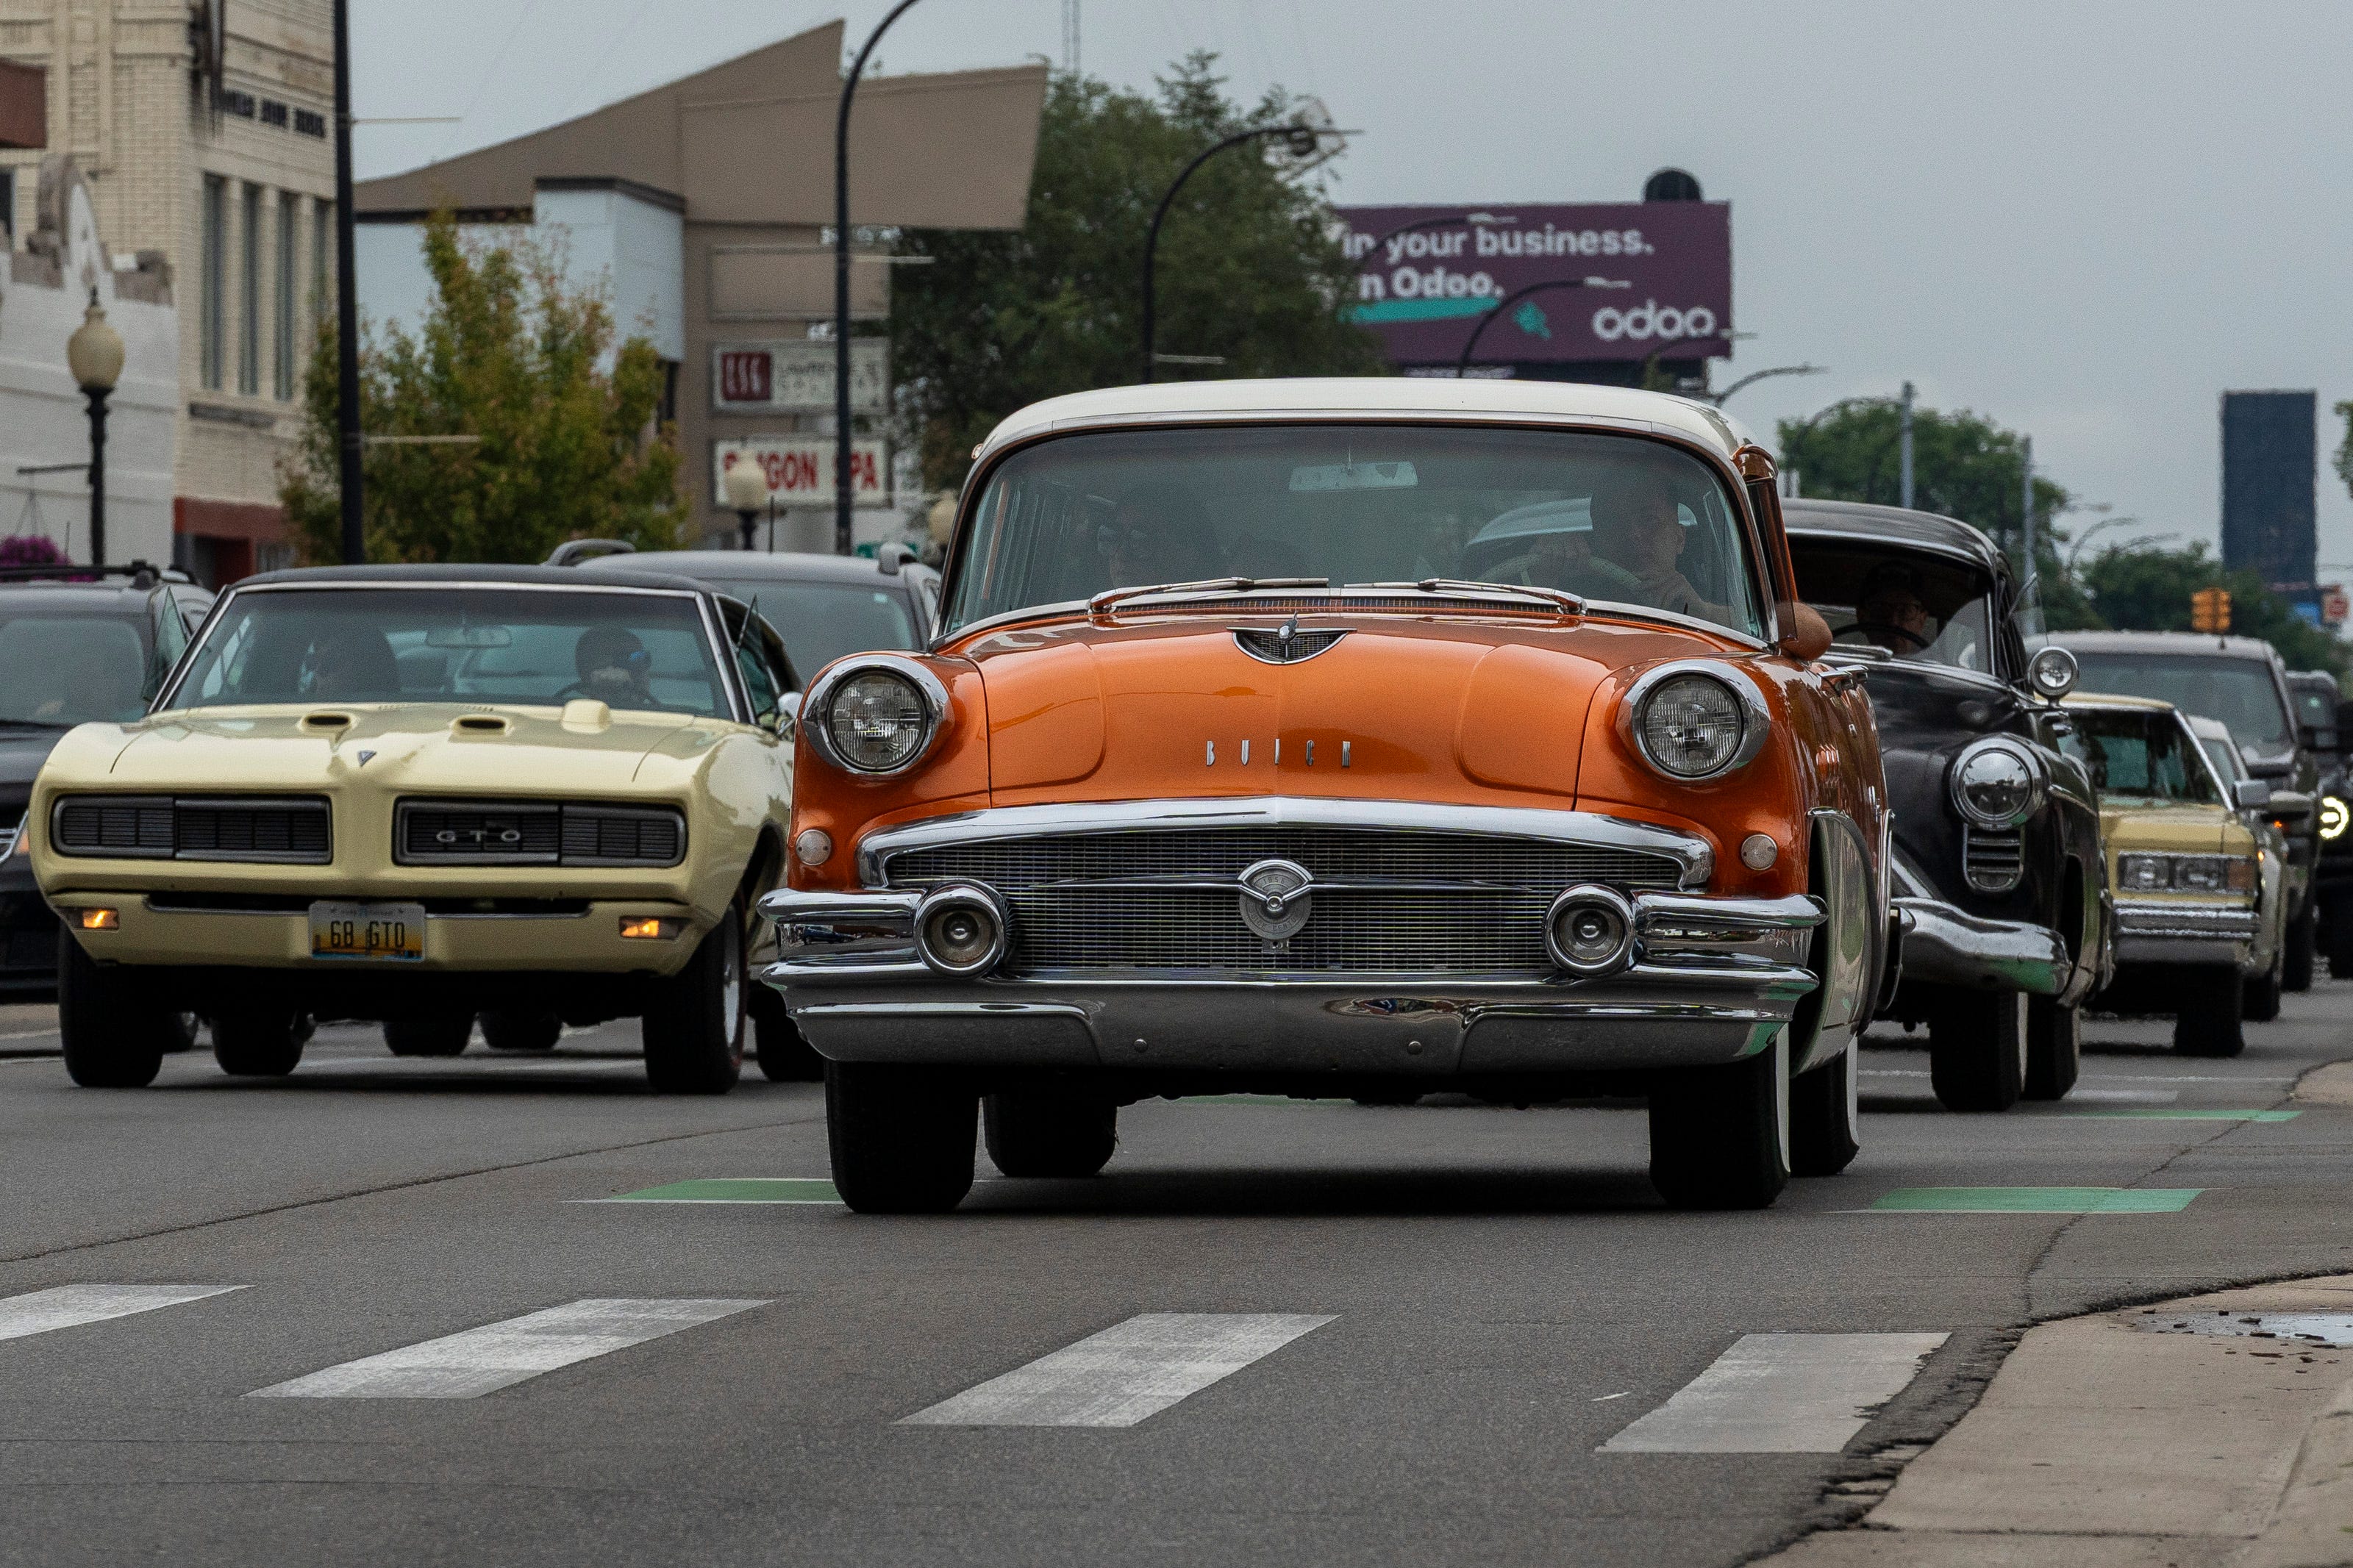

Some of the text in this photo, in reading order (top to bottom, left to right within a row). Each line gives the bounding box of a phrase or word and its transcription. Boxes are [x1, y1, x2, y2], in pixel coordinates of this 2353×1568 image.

[1385, 232, 1468, 265] your
[1477, 223, 1654, 256] business.
[1392, 266, 1505, 298] Odoo.
[1592, 299, 1717, 341] odoo
[1205, 738, 1352, 767] BUICK
[435, 830, 521, 843] GTO
[330, 920, 405, 948] 68 GTO
